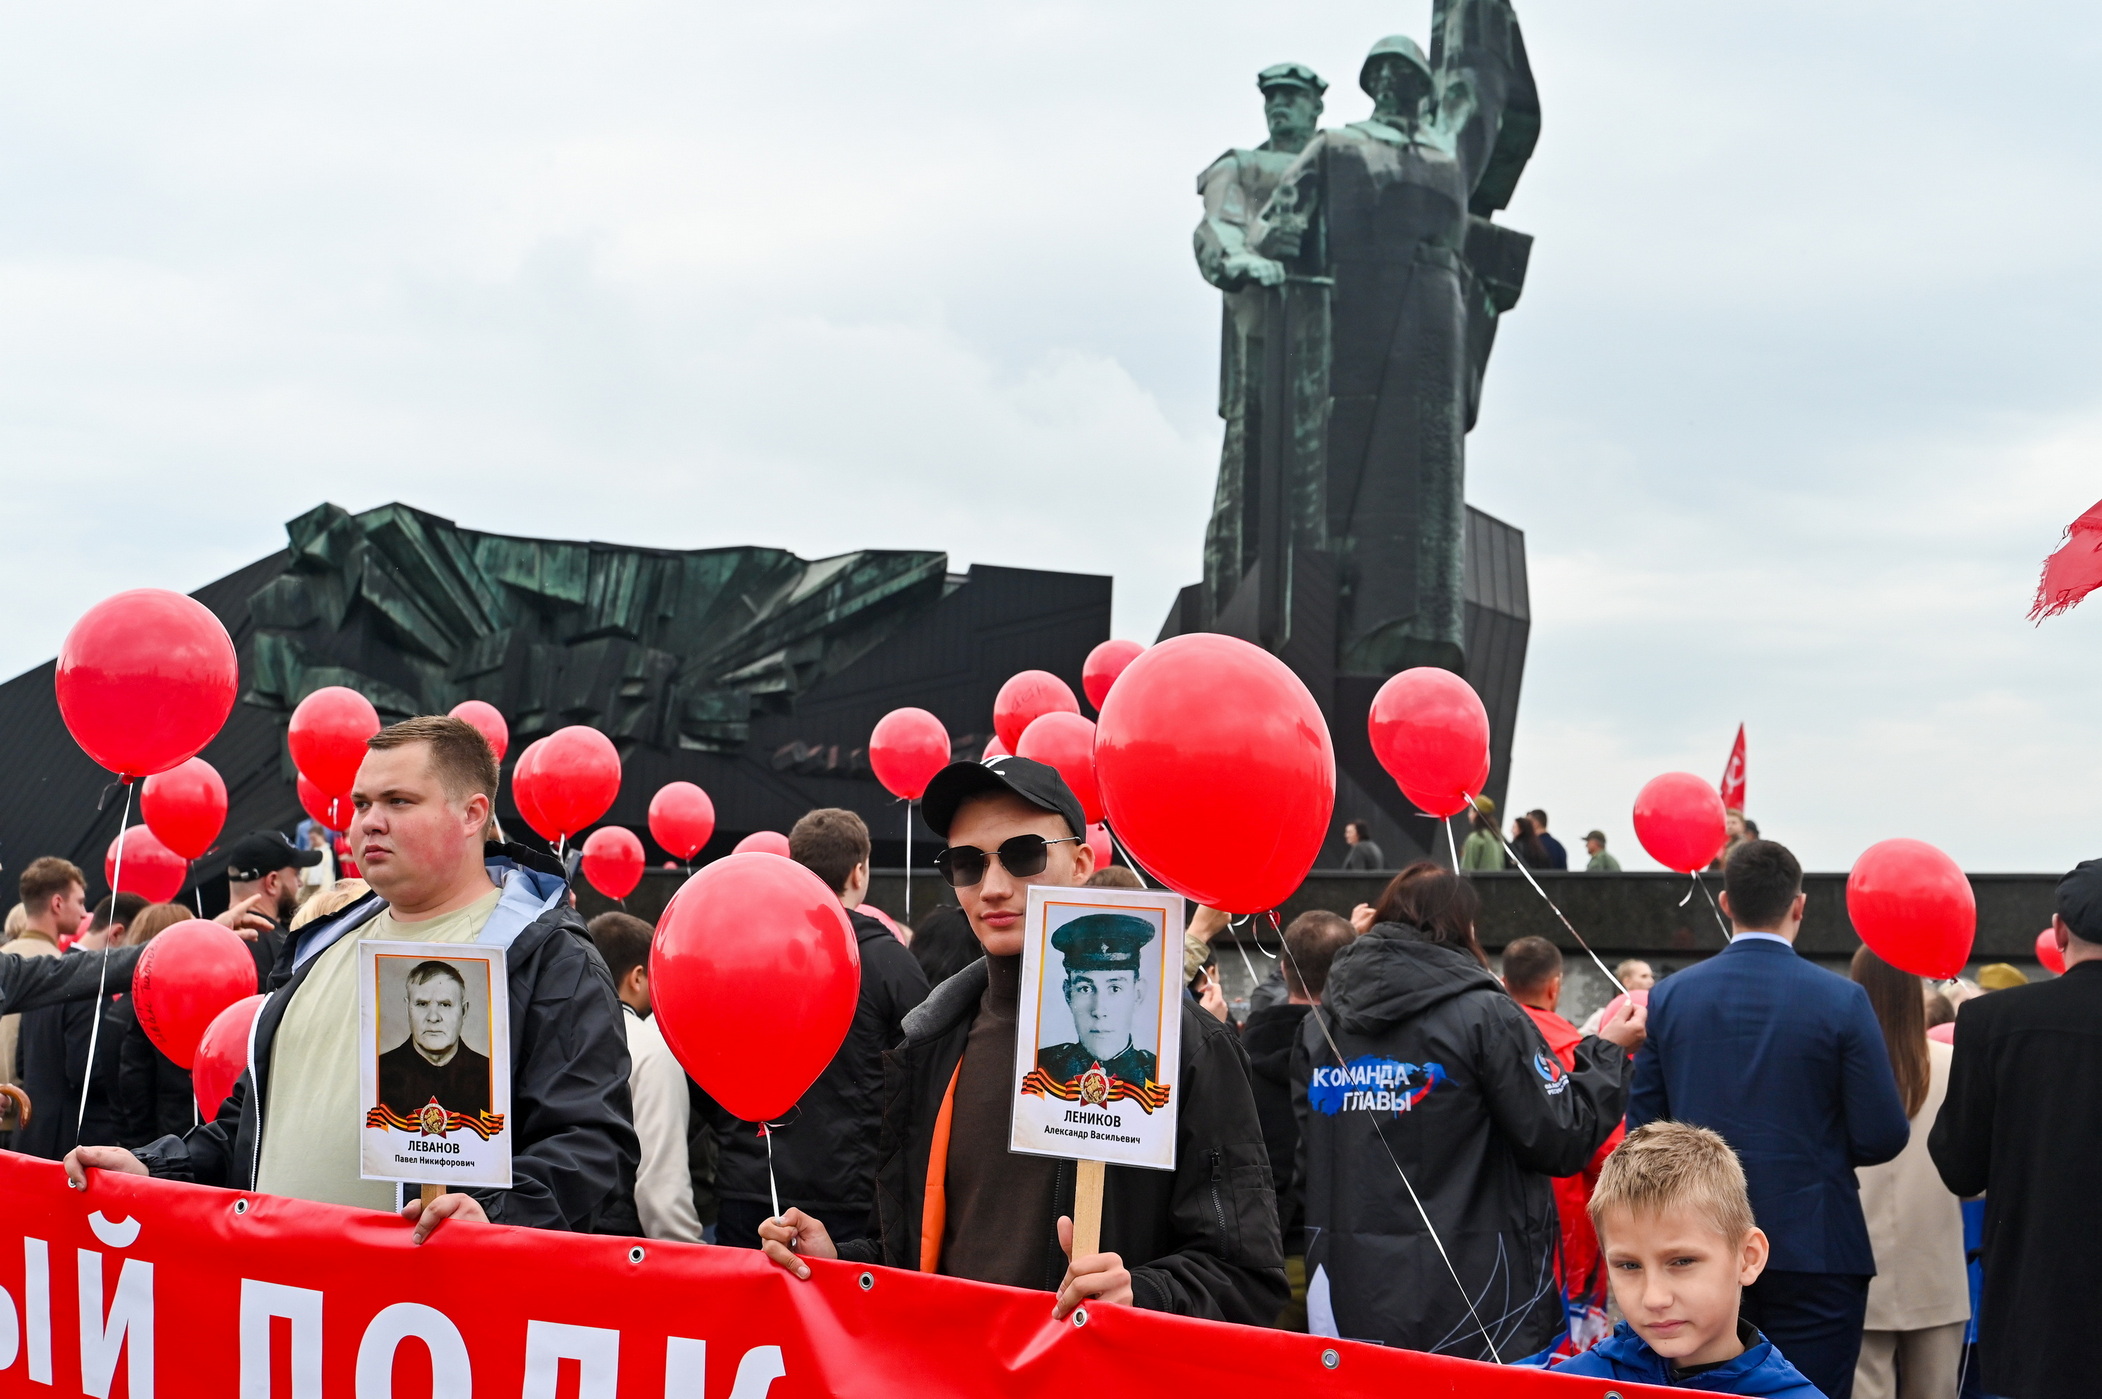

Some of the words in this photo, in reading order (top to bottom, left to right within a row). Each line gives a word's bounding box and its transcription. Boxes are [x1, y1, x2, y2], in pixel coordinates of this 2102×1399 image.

[1313, 1065, 1411, 1088] КОМАНДА
[1342, 1091, 1412, 1112] ГЛАВЫ
[1063, 1110, 1122, 1128] ЛЕНИКОВ
[1044, 1125, 1089, 1140] Александр
[1090, 1130, 1141, 1145] Васильевич
[408, 1140, 461, 1154] ЛЕВАНОВ
[394, 1154, 418, 1164] Павел
[419, 1156, 475, 1168] Никифорович
